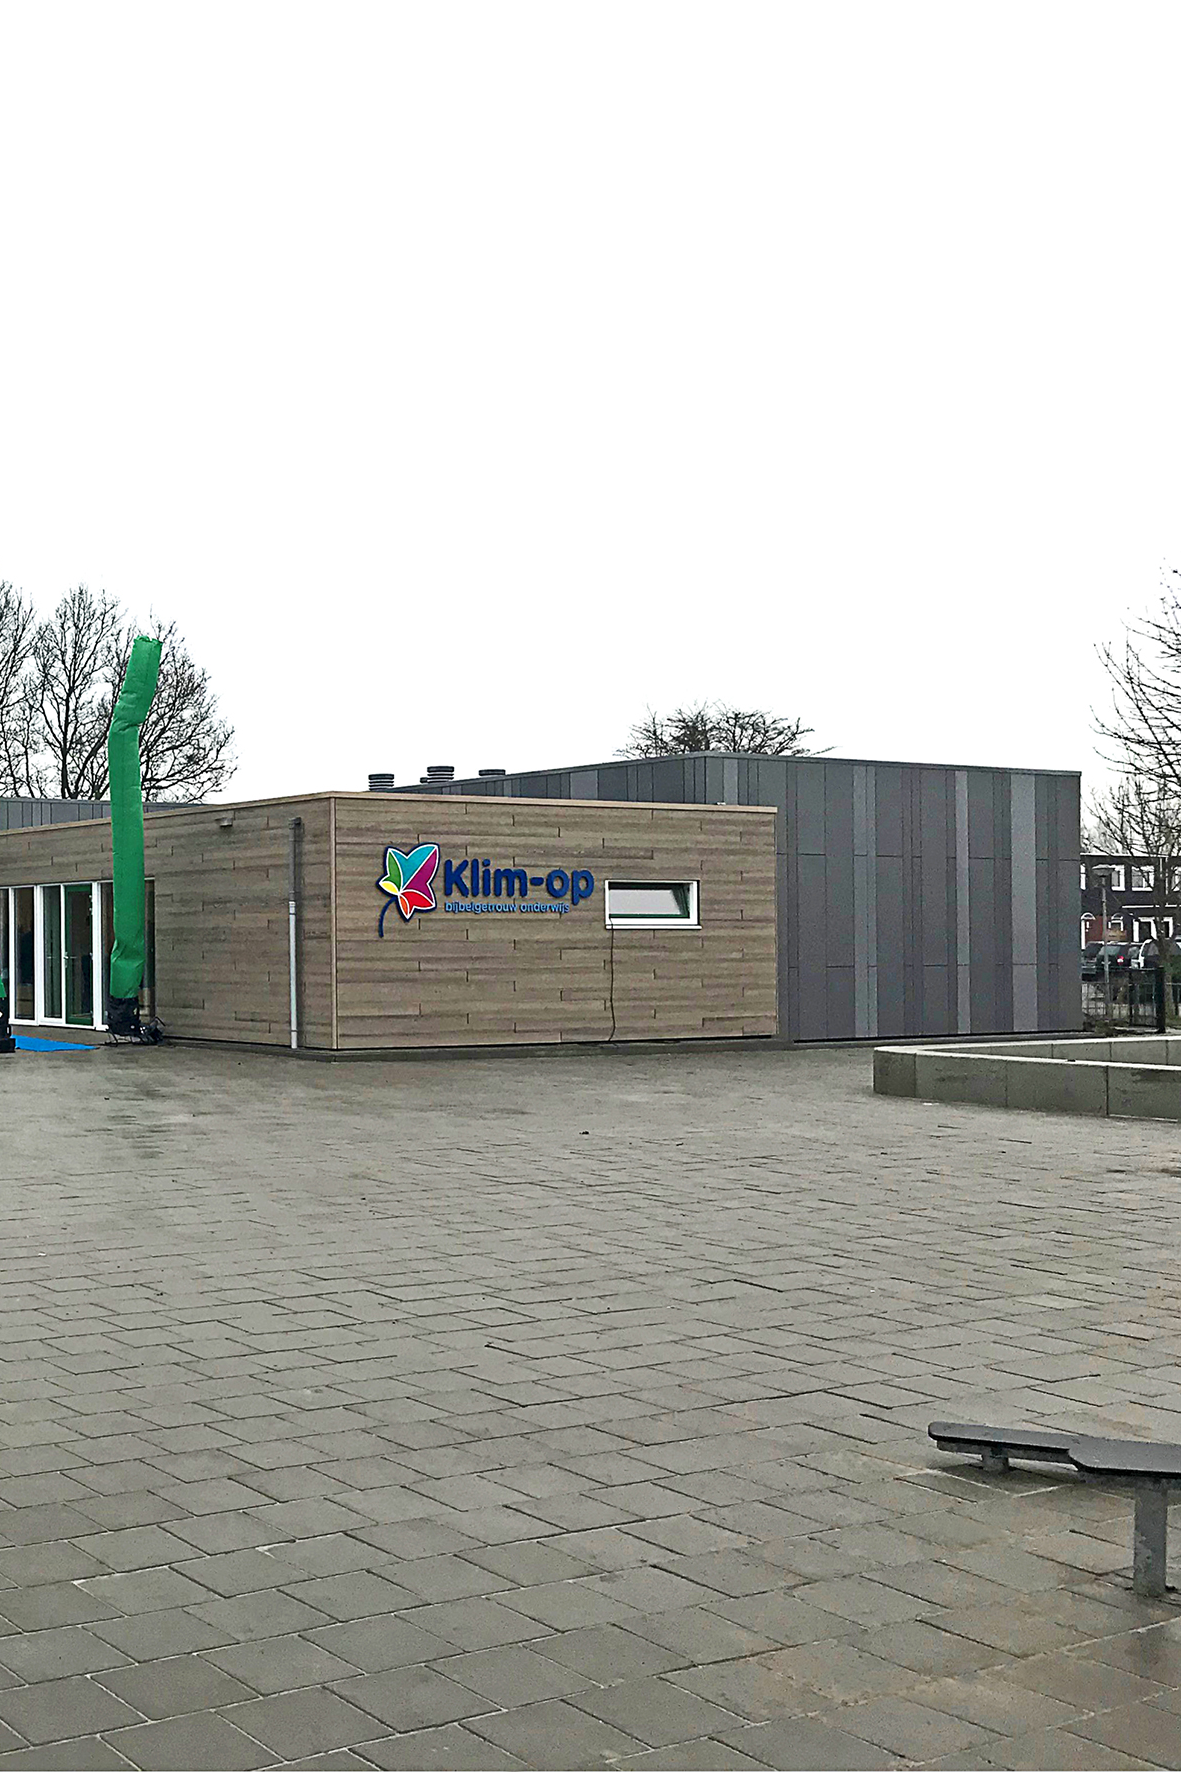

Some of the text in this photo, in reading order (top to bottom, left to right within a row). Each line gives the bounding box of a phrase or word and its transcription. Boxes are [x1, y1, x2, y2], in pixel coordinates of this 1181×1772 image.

[444, 858, 594, 905] Klim-op
[445, 901, 570, 914] bijbelgetrouw onderwijs
